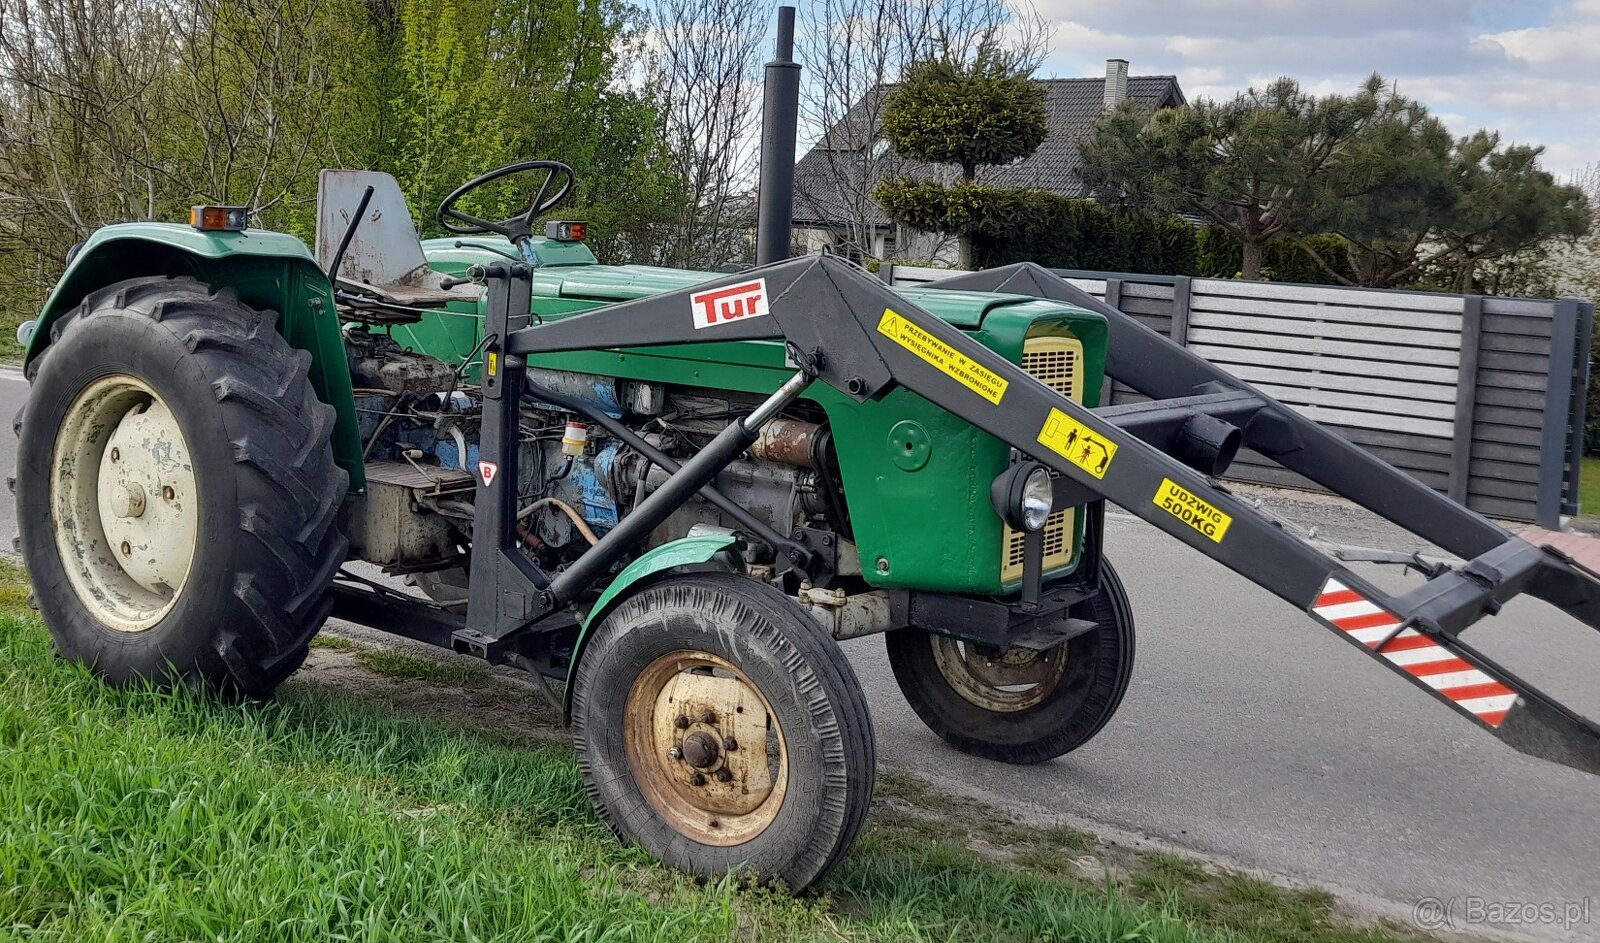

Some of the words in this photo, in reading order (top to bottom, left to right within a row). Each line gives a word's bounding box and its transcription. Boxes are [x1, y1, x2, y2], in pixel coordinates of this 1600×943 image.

[694, 282, 762, 323] Tur
[900, 333, 945, 366] WYSIĘGNIKA
[948, 363, 999, 398] WZBRONIONE
[904, 323, 955, 359] PRZEBYWANIE
[959, 357, 967, 366] W
[969, 364, 1004, 388] ZASIĘGU
[483, 466, 492, 478] B
[1162, 497, 1217, 536] 500KG
